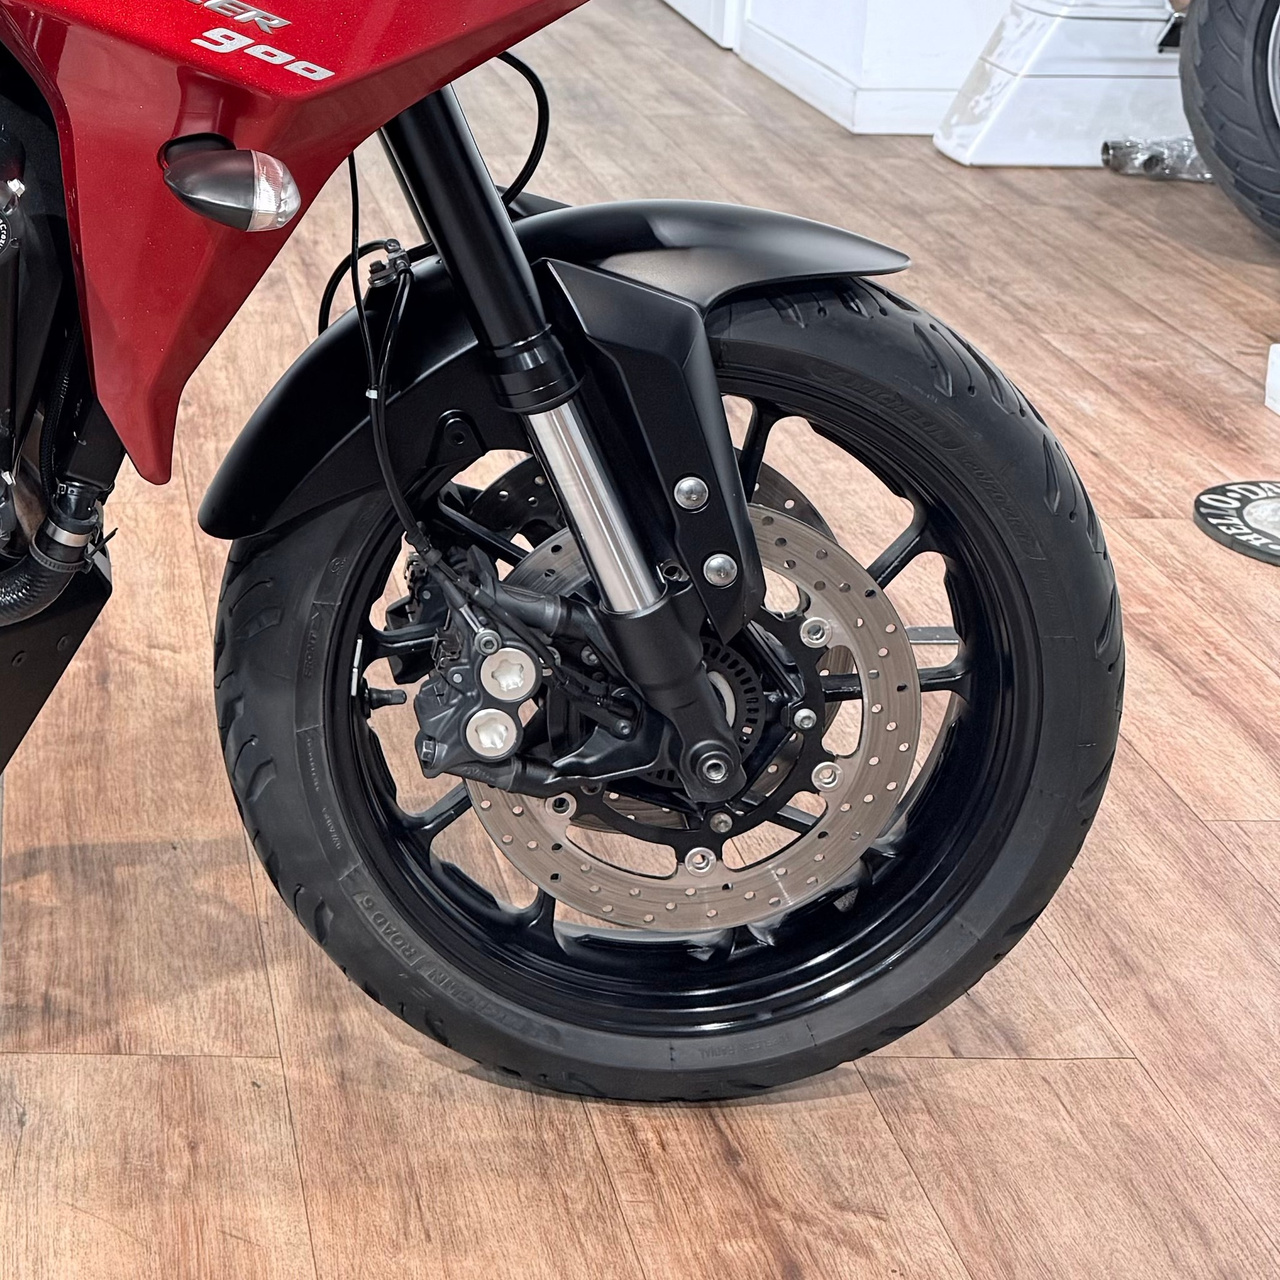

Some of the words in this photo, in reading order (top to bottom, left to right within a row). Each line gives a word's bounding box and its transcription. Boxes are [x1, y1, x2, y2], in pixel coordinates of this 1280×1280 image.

[191, 27, 335, 81] 900
[1224, 482, 1280, 500] DA
[1199, 493, 1273, 547] HELLO
[369, 909, 418, 959] ROAD
